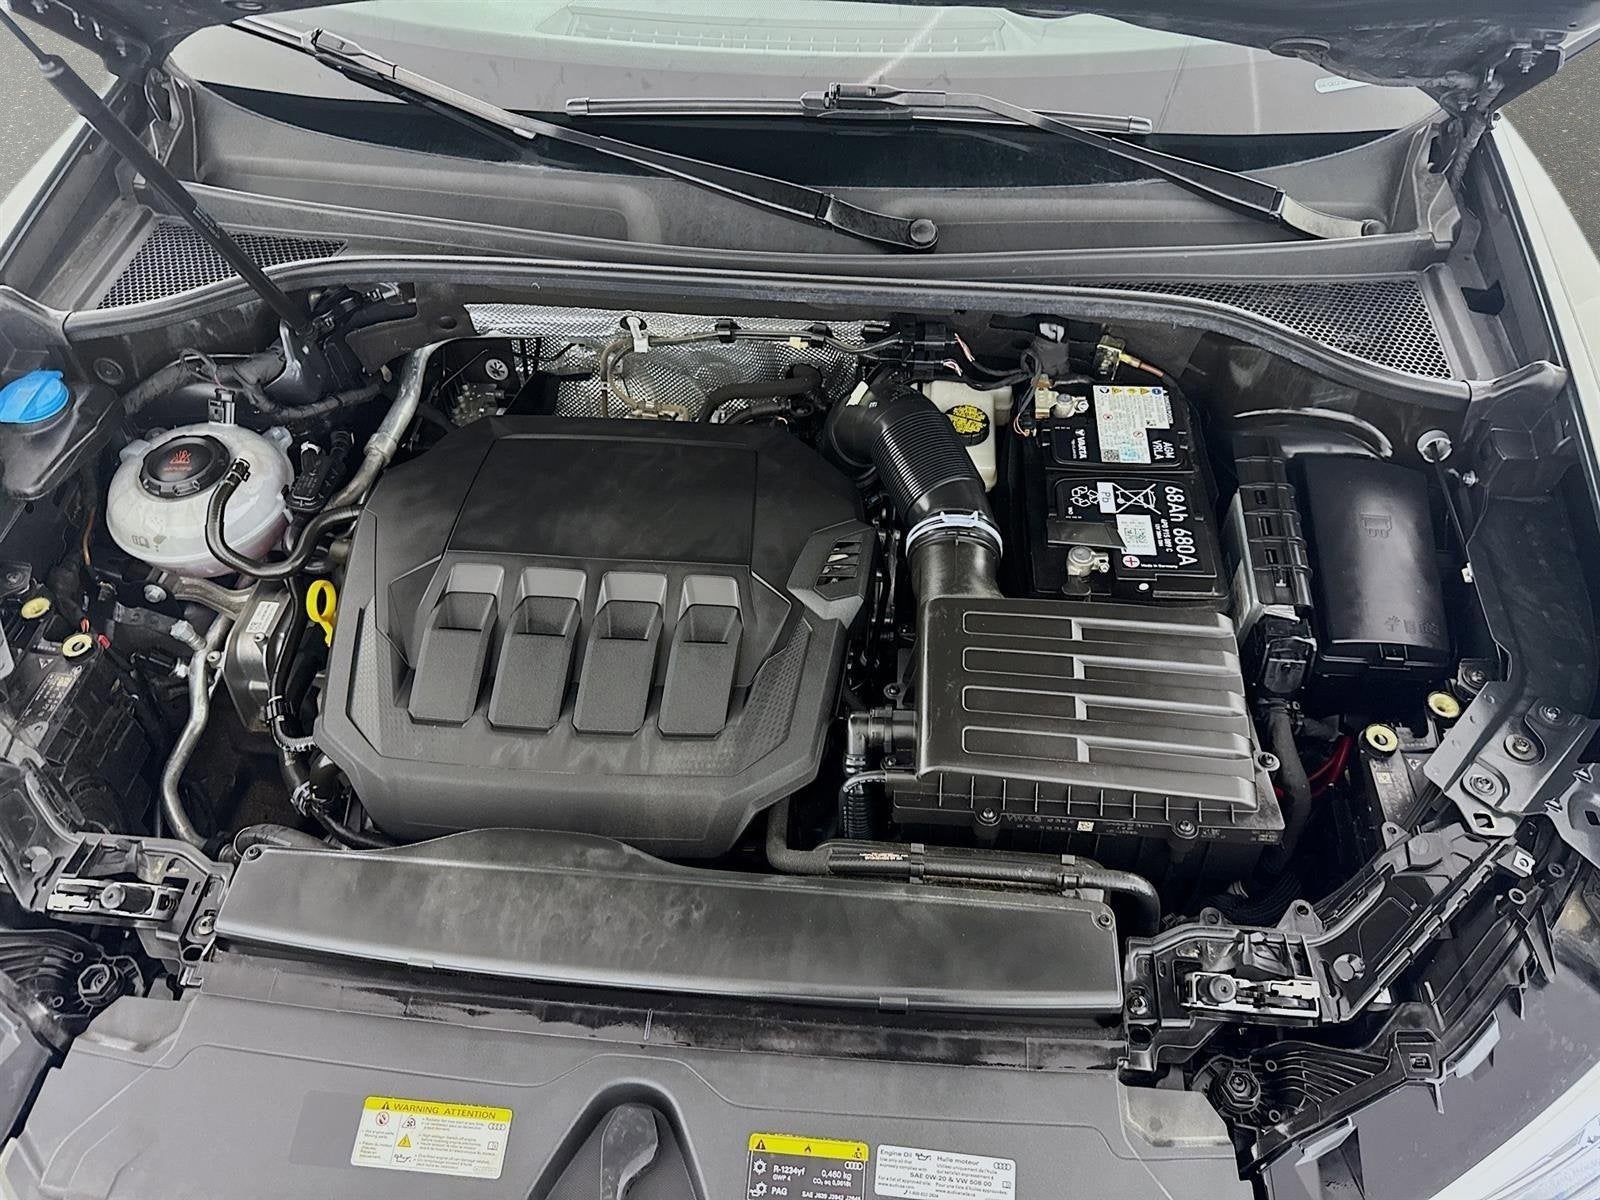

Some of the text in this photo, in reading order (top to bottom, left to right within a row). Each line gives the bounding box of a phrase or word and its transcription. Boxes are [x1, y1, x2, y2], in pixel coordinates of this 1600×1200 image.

[1078, 436, 1087, 459] VARTA
[1152, 440, 1164, 460] VRLA
[1162, 442, 1175, 459] AGM
[1165, 486, 1198, 566] 68Ah 680A
[394, 1103, 497, 1119] WARNING ATTENTION
[773, 1165, 806, 1176] R-1234yf
[843, 1172, 852, 1181] kg
[771, 1186, 787, 1196] PAG
